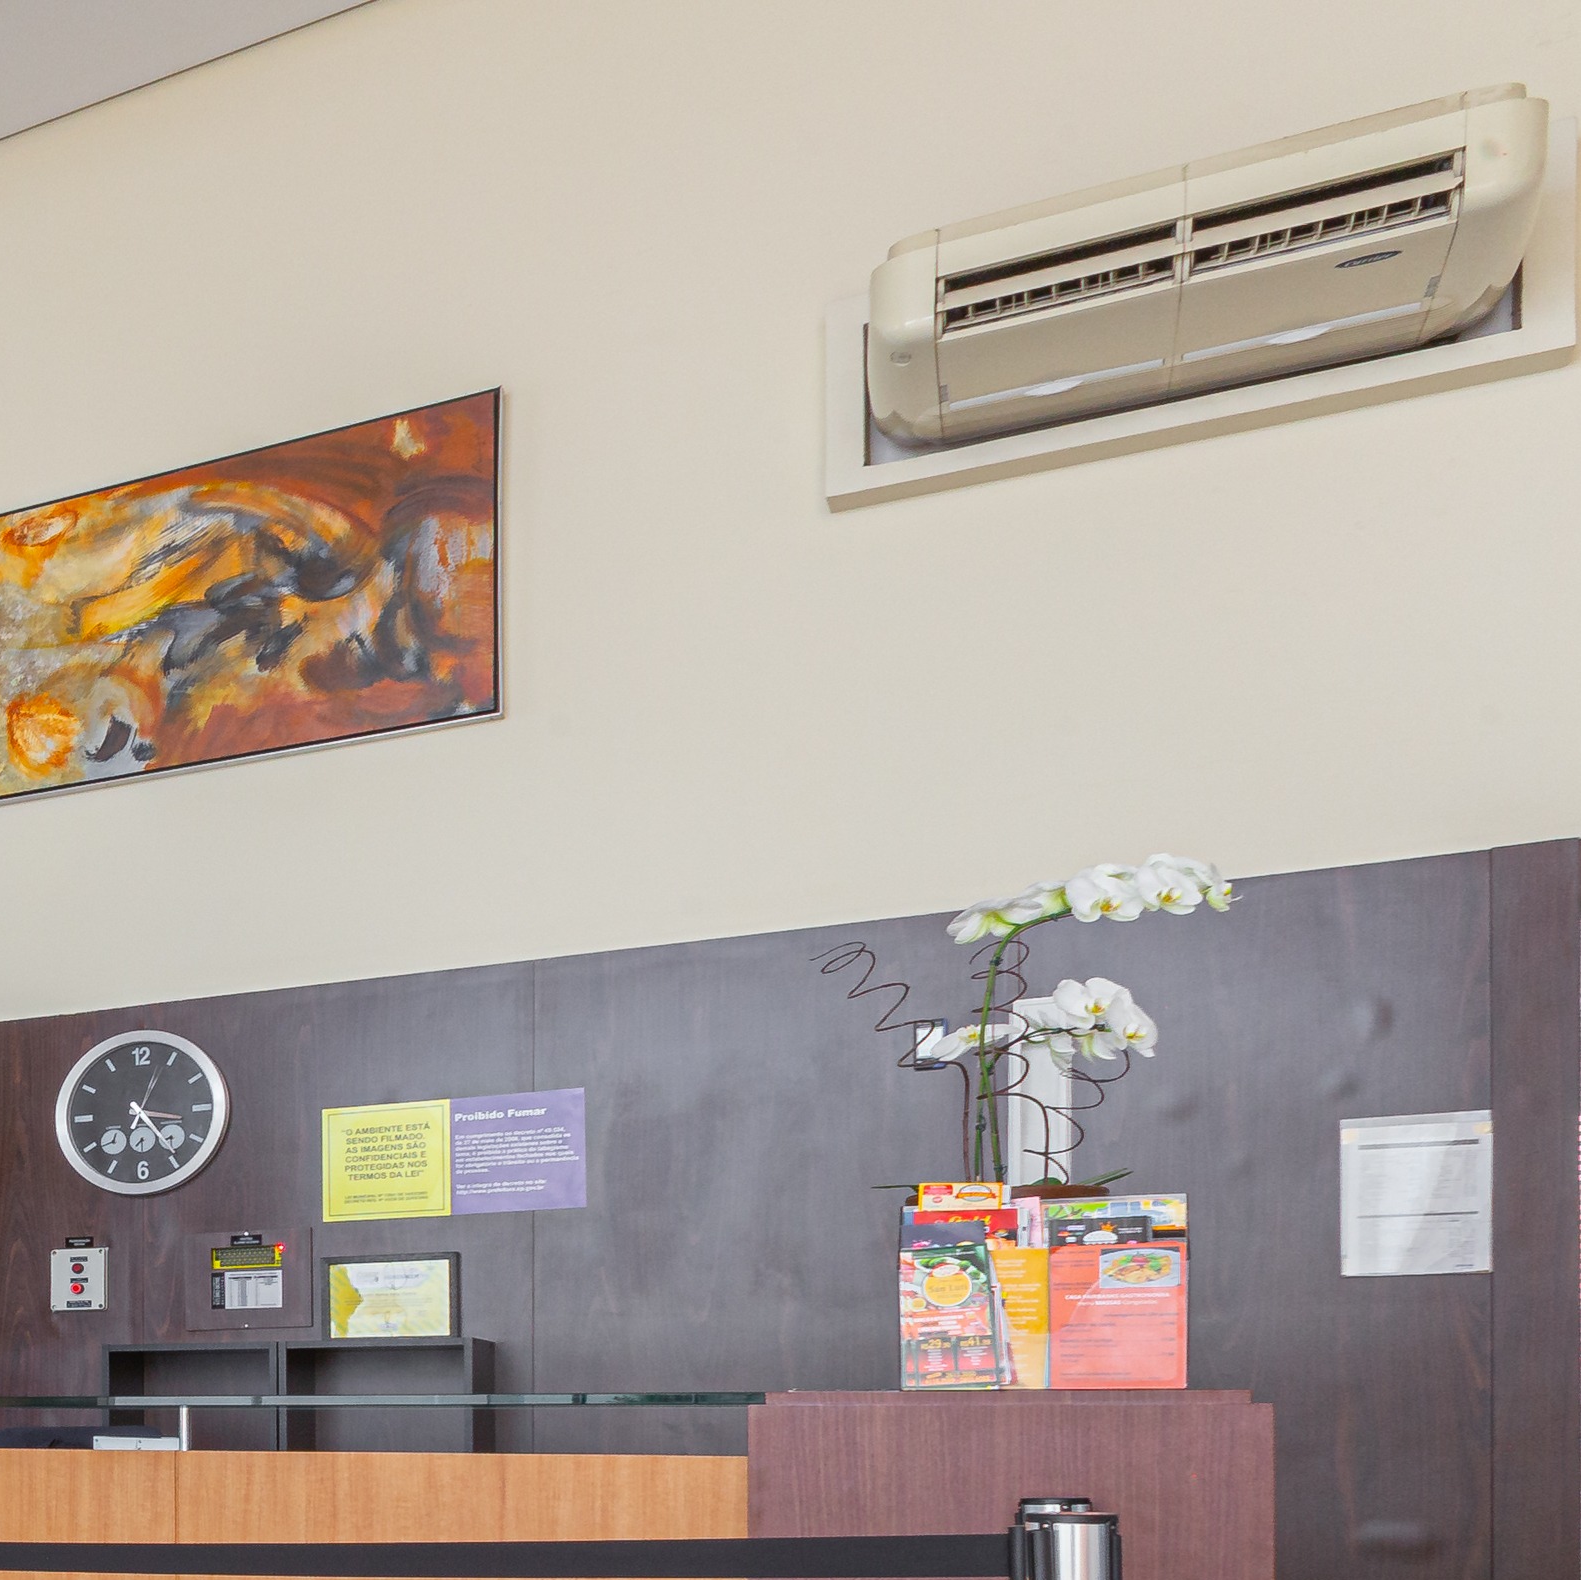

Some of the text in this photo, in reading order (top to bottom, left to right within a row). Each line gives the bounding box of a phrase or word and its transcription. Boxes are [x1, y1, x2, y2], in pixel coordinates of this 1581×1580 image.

[131, 1047, 150, 1066] 12
[455, 1108, 547, 1122] Proibido Fumar
[355, 1125, 403, 1135] AMBIENTE
[405, 1122, 430, 1132] ESTÁ
[346, 1136, 378, 1145] SENDO
[345, 1142, 426, 1154] AS IMAGENS SÃO
[345, 1153, 417, 1163] CONFIDENCIAIS
[137, 1161, 149, 1180] 6
[344, 1160, 427, 1172] PROTEGIDAS NOS
[348, 1172, 387, 1181] TERMOS
[389, 1171, 402, 1179] DA
